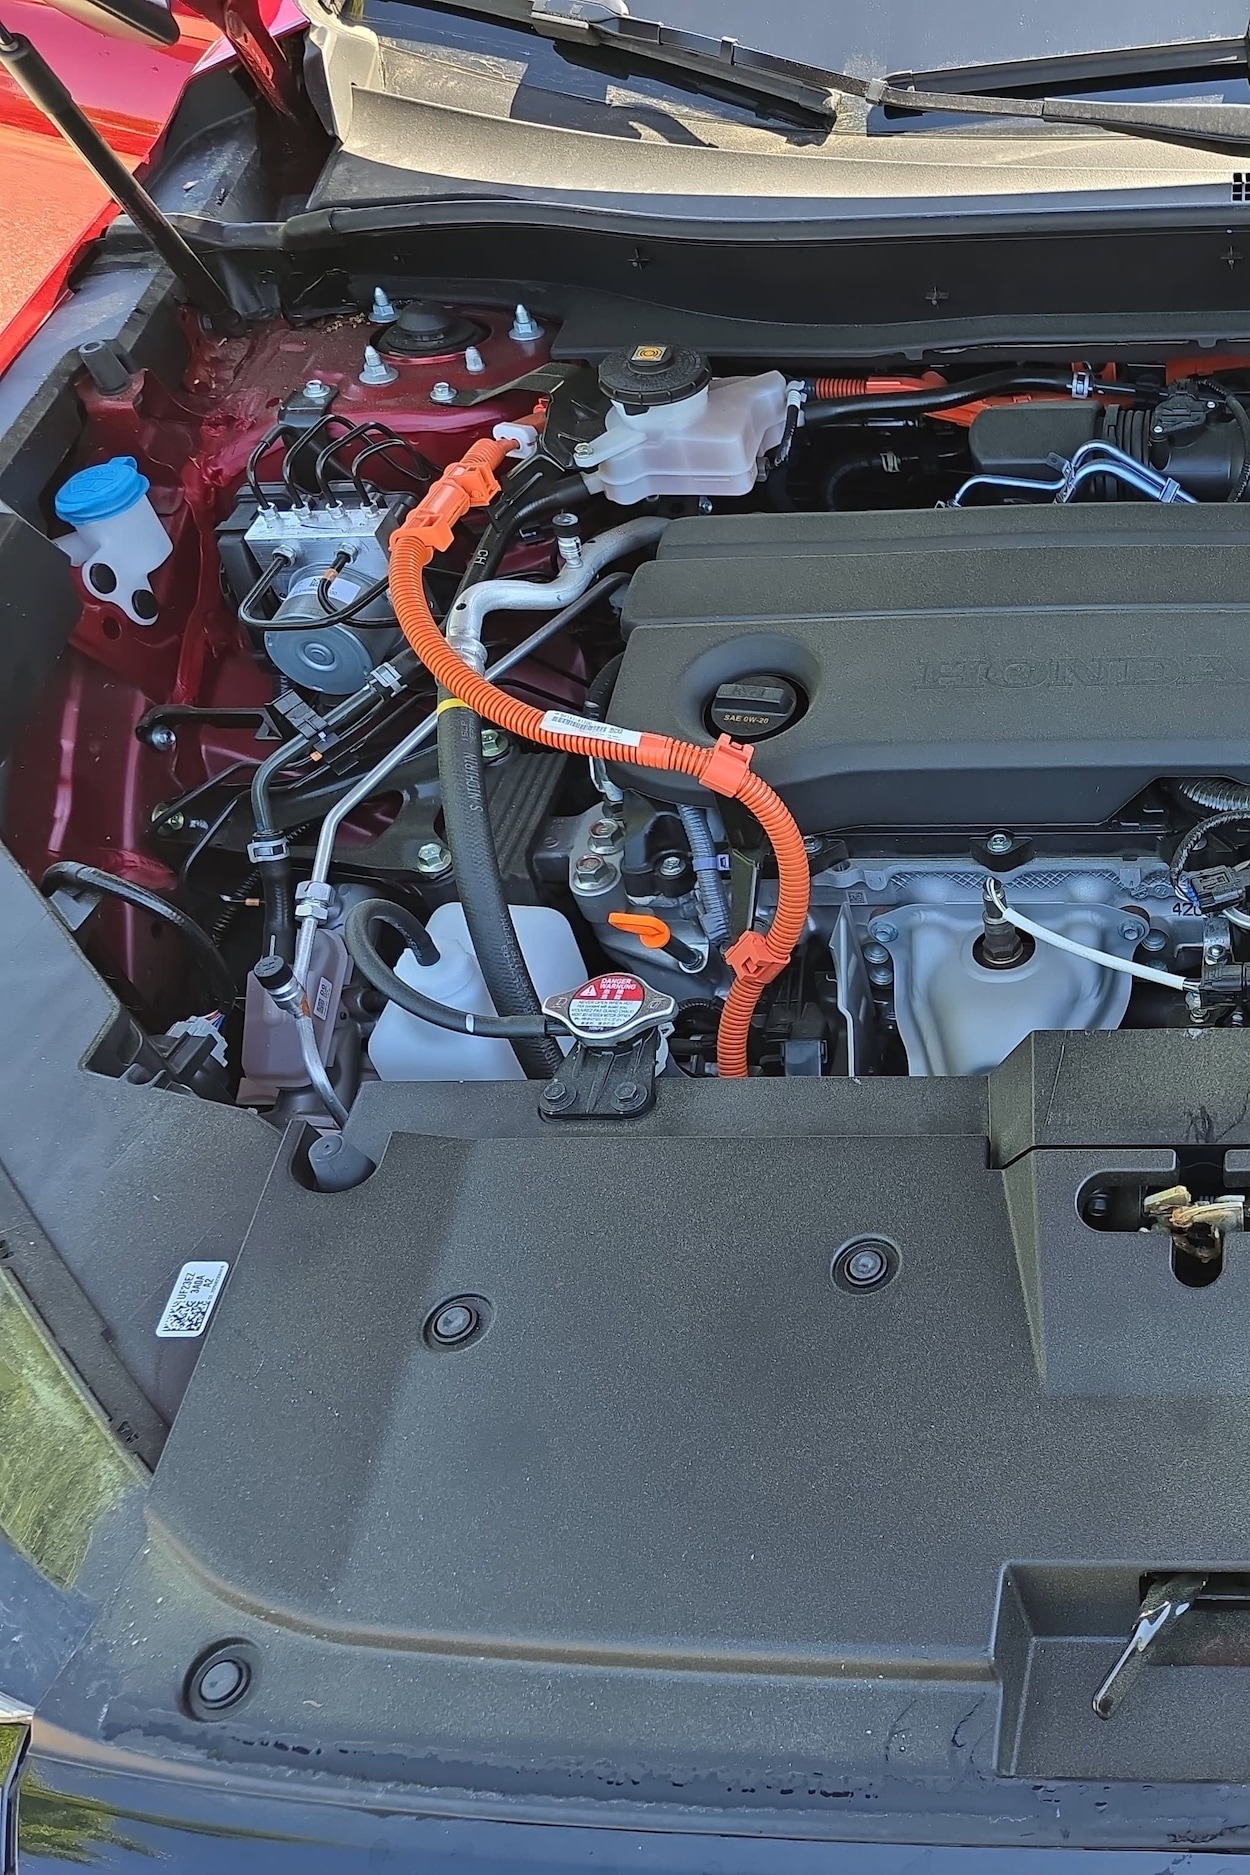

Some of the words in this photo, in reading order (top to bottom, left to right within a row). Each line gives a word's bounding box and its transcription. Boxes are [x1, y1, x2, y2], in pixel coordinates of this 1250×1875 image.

[474, 549, 489, 565] CH
[916, 654, 1250, 689] HONDA
[723, 714, 742, 722] SAE
[743, 716, 769, 724] 0W-20
[464, 752, 482, 802] NICHIRIN
[177, 1272, 196, 1300] UF23EZ
[203, 1278, 214, 1288] A2
